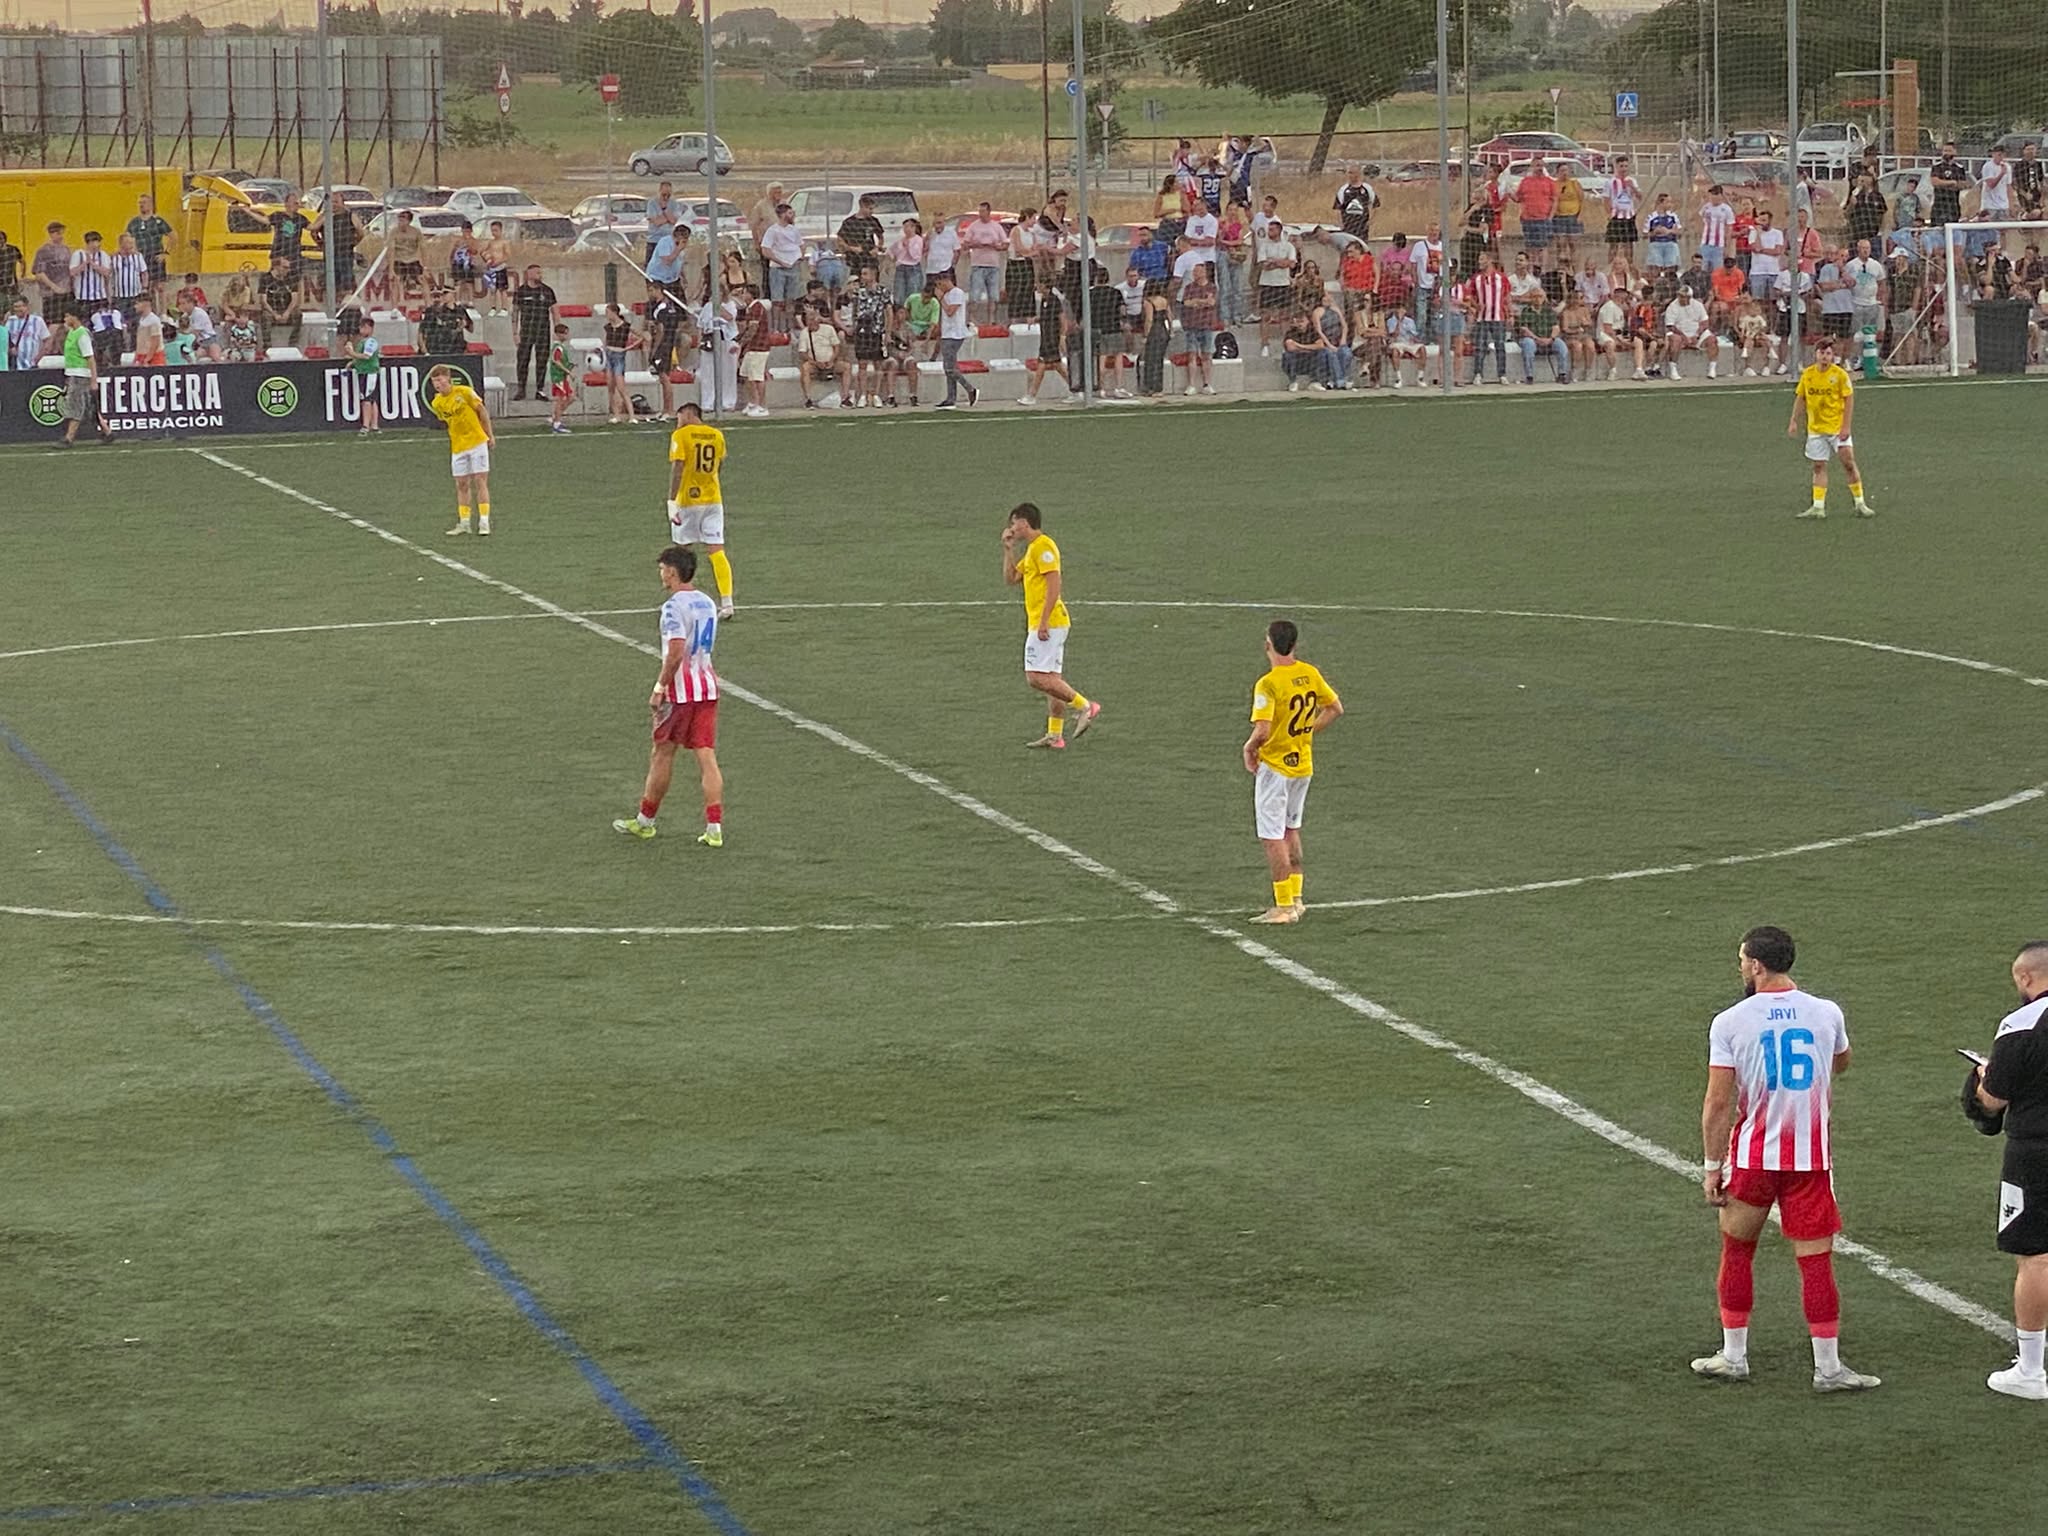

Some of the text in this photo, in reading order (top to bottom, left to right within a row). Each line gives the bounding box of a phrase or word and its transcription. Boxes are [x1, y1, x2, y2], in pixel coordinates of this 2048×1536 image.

[1203, 178, 1220, 194] 28
[96, 373, 222, 414] TERCERA
[325, 366, 422, 422] FUUR
[97, 413, 224, 431] EDERACIÓN
[695, 443, 715, 473] 19
[691, 617, 714, 656] 14
[1288, 691, 1317, 737] 22
[1767, 1008, 1796, 1020] JAVI
[1760, 1028, 1814, 1091] 16
